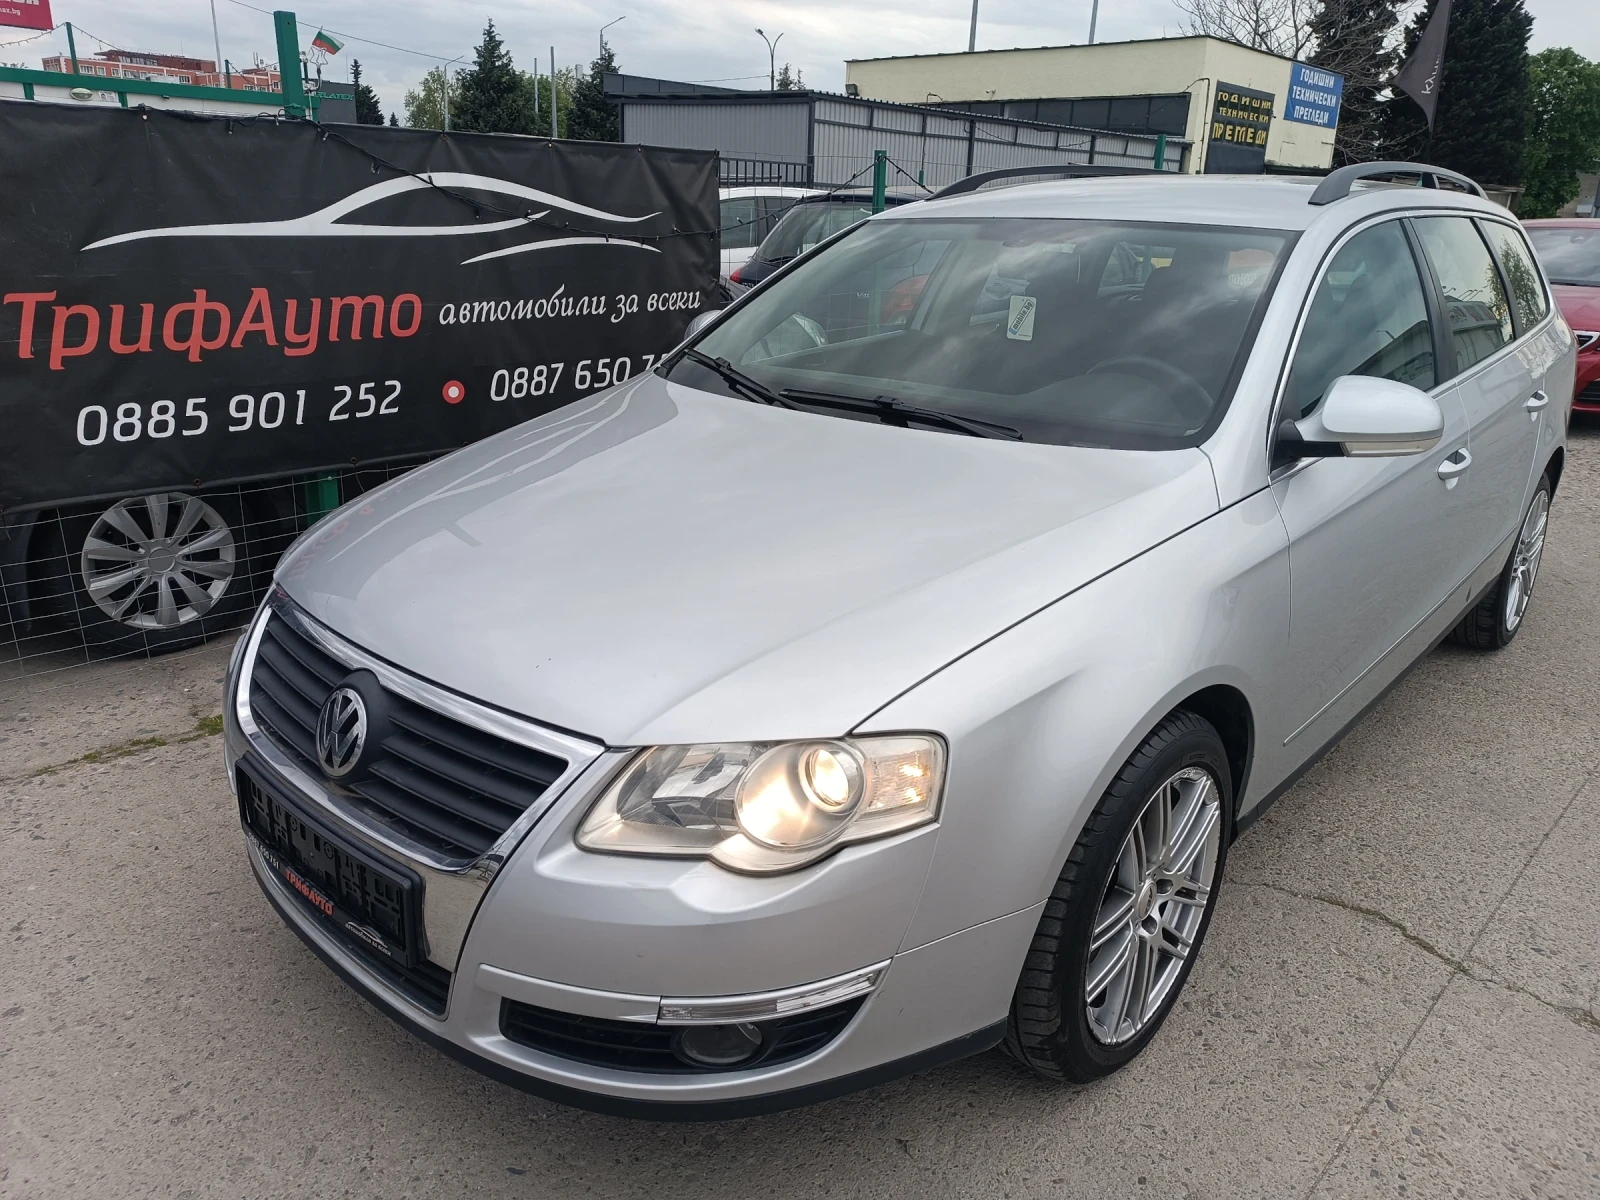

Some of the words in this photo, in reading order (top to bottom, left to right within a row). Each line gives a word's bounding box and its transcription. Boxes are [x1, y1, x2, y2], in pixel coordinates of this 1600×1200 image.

[1292, 85, 1337, 108] ТЕХНИЧЕСКИ
[1300, 67, 1335, 88] ГОДИШНИ
[1293, 105, 1330, 125] ПРЕГЛЕДИ
[438, 283, 607, 326] автомобили
[610, 294, 639, 324] за
[646, 290, 702, 313] всеки
[1012, 301, 1034, 330] mobile.bg
[3, 287, 422, 370] ТрифАуто
[489, 362, 565, 402] 0887
[574, 356, 632, 390] 650
[642, 353, 670, 372] 7
[76, 397, 209, 446] 0885
[228, 389, 306, 432] 901
[328, 379, 402, 421] 252
[285, 868, 333, 915] ТРИФАУТО
